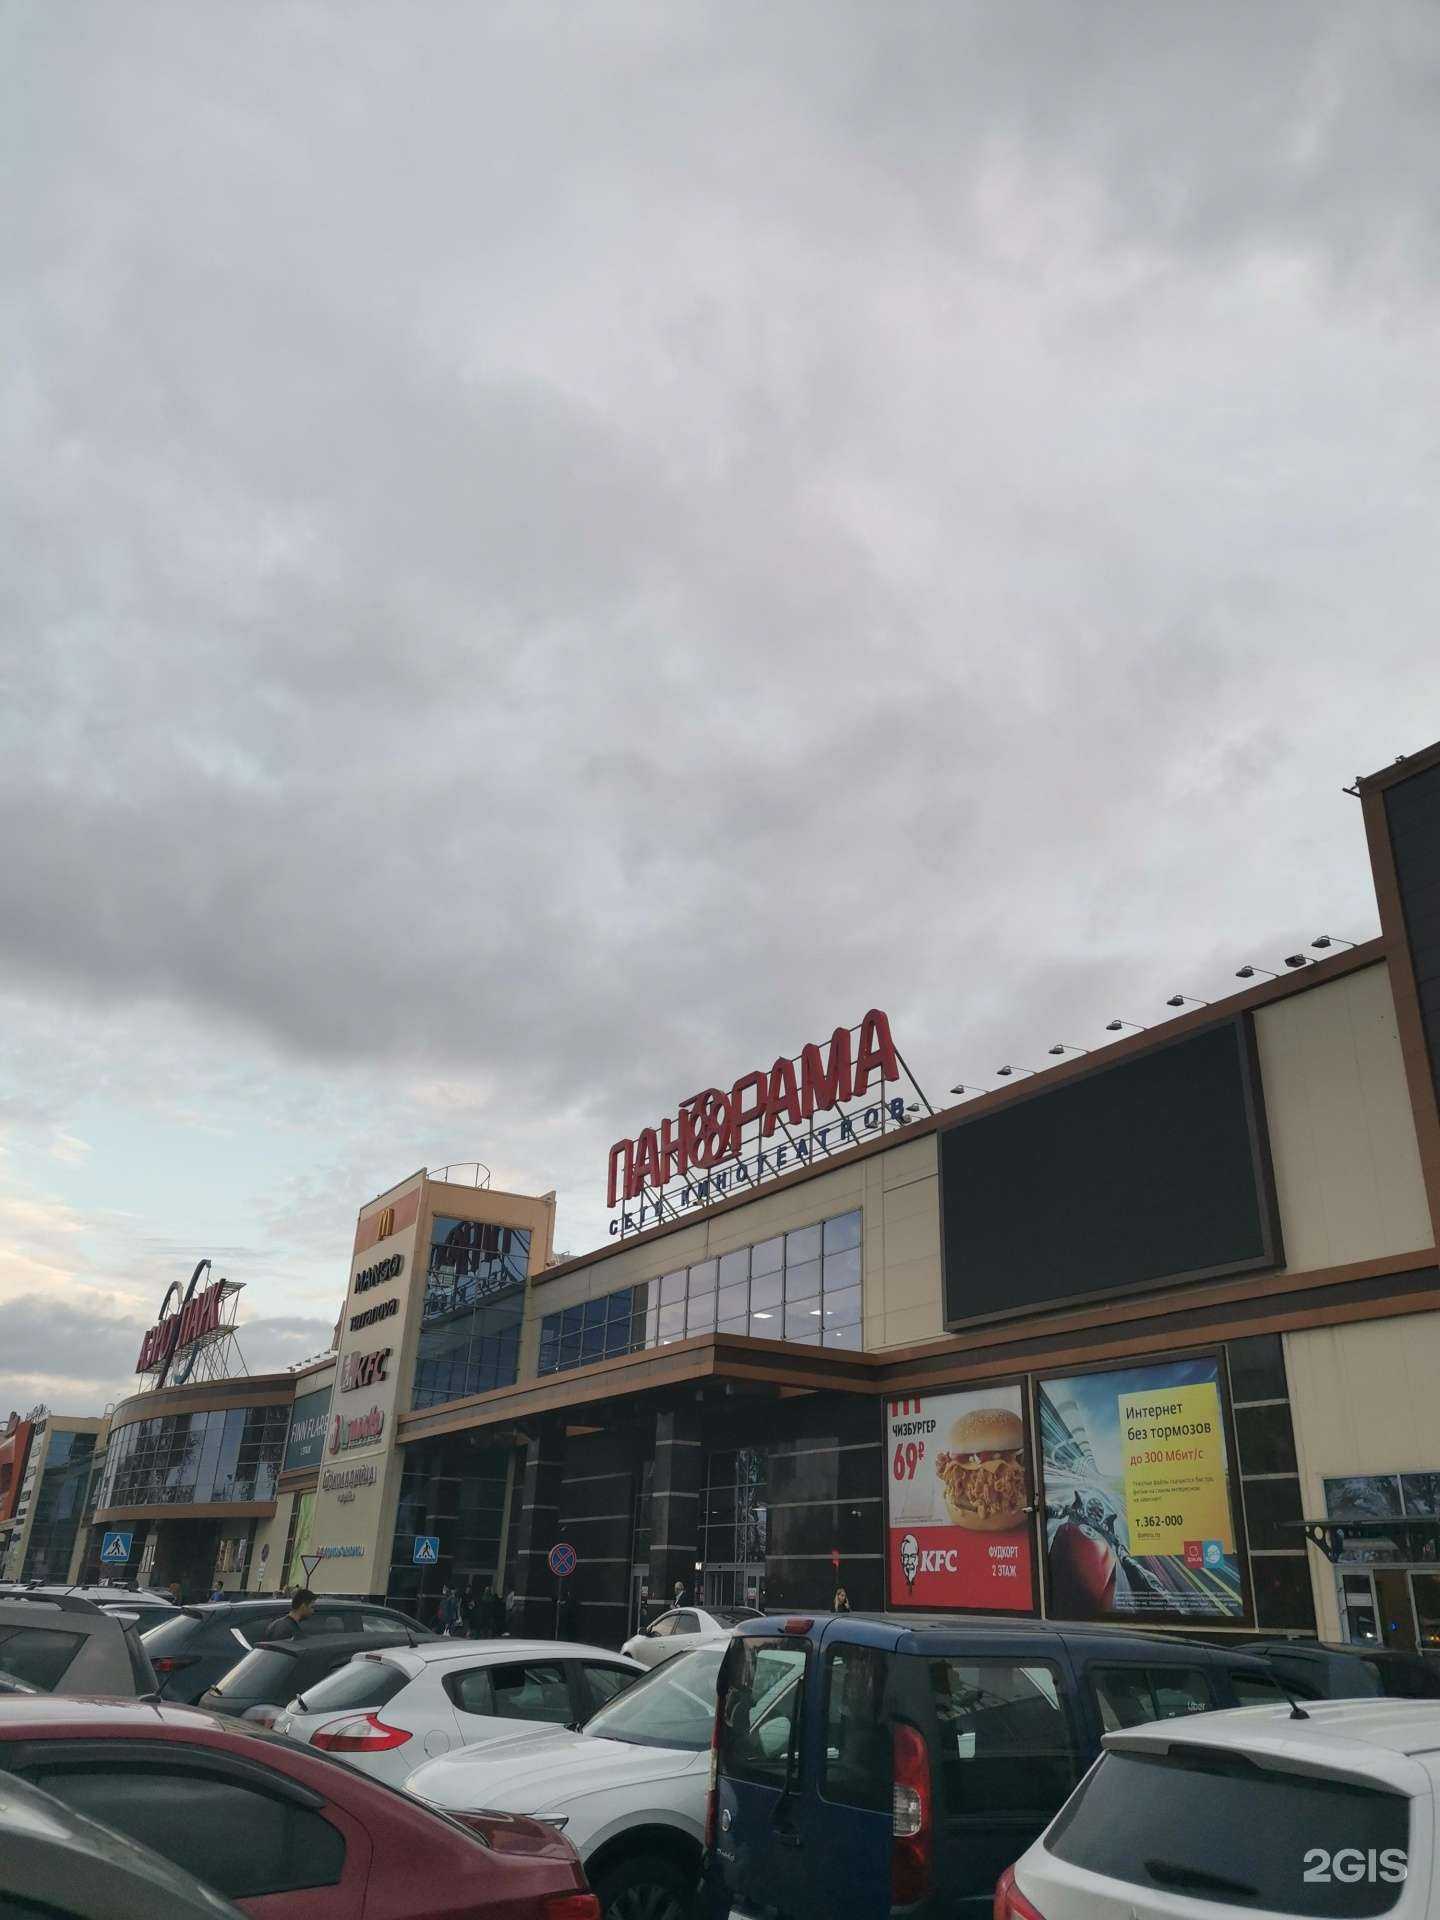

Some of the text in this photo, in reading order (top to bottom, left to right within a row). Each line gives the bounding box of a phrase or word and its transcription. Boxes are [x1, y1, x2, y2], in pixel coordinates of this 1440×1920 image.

[607, 1008, 900, 1208] ПАНОРАМА
[350, 1350, 388, 1390] KFC
[1125, 1403, 1184, 1420] Интернет
[892, 1419, 936, 1437] ЧИЗБУРГЕР
[1127, 1422, 1212, 1441] без тормозов
[1129, 1448, 1204, 1466] до 300 Мбит/с
[1135, 1514, 1183, 1528] т.362-000
[920, 1549, 958, 1572] KFC
[988, 1545, 1018, 1559] ФУДКОРТ
[991, 1564, 1017, 1577] 2 ЭТАЖ
